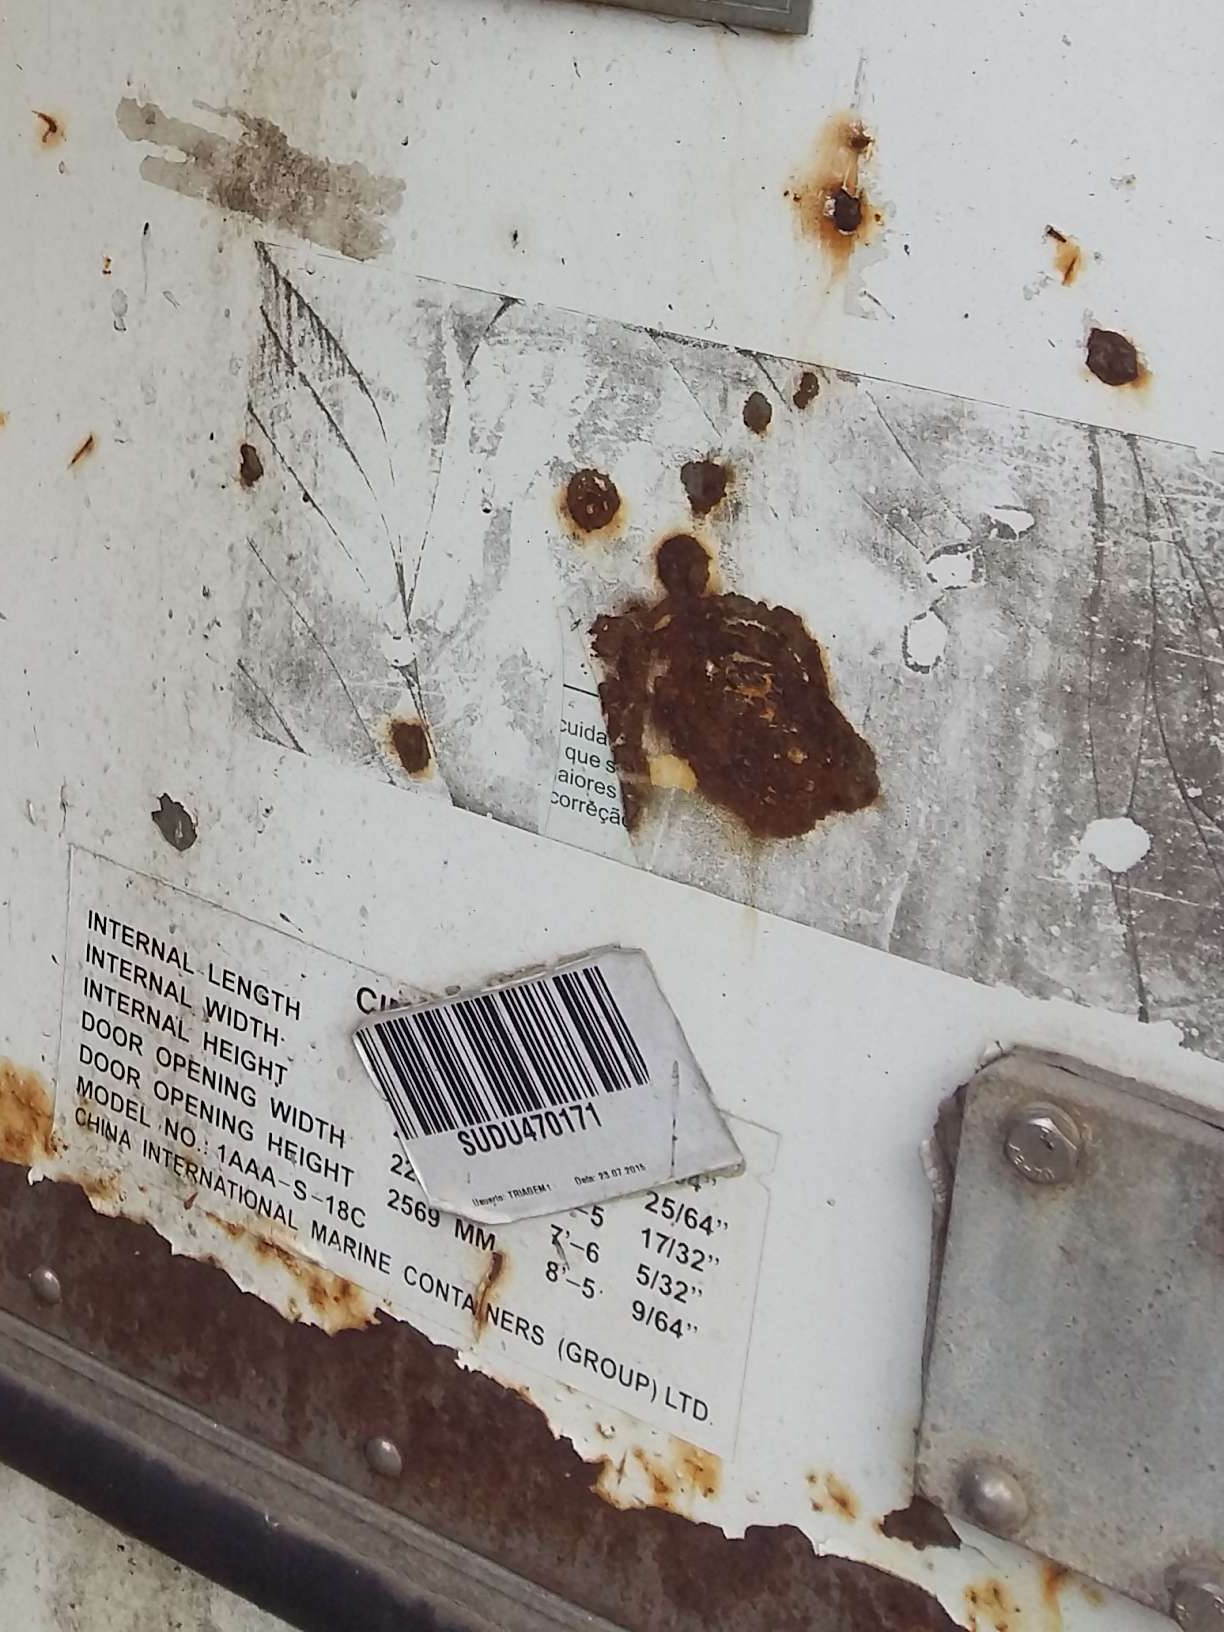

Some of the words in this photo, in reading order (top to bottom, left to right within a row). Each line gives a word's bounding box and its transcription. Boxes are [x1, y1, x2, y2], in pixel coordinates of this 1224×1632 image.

[565, 745, 601, 768] que
[85, 943, 192, 1009] INTERNAL
[205, 996, 279, 1048] WIDTH
[87, 909, 194, 975] INTERNAL
[207, 962, 301, 1021] LENGTH
[81, 1010, 144, 1057] DOOR
[155, 1046, 257, 1108] OPENING
[270, 1096, 346, 1149] WIDTH
[83, 976, 190, 1043] INTERNAL
[203, 1031, 288, 1086] HEIGHT
[76, 1075, 151, 1128] MODEL
[217, 1144, 368, 1229] 1AAA-S-18C
[78, 1043, 141, 1091] DOOR
[153, 1080, 254, 1142] OPENING
[267, 1132, 355, 1188] HEIGHT
[386, 1188, 441, 1229] 2569
[454, 1217, 497, 1252] MM
[456, 1101, 603, 1157] SUDU470171
[75, 1107, 131, 1151] CHINA
[142, 1139, 299, 1231] INTERNATIONAL
[310, 1219, 393, 1276] MARINE
[403, 1264, 546, 1347] CONTANERS
[557, 1336, 658, 1404] (GROUP)
[665, 1385, 714, 1427] LTD.
